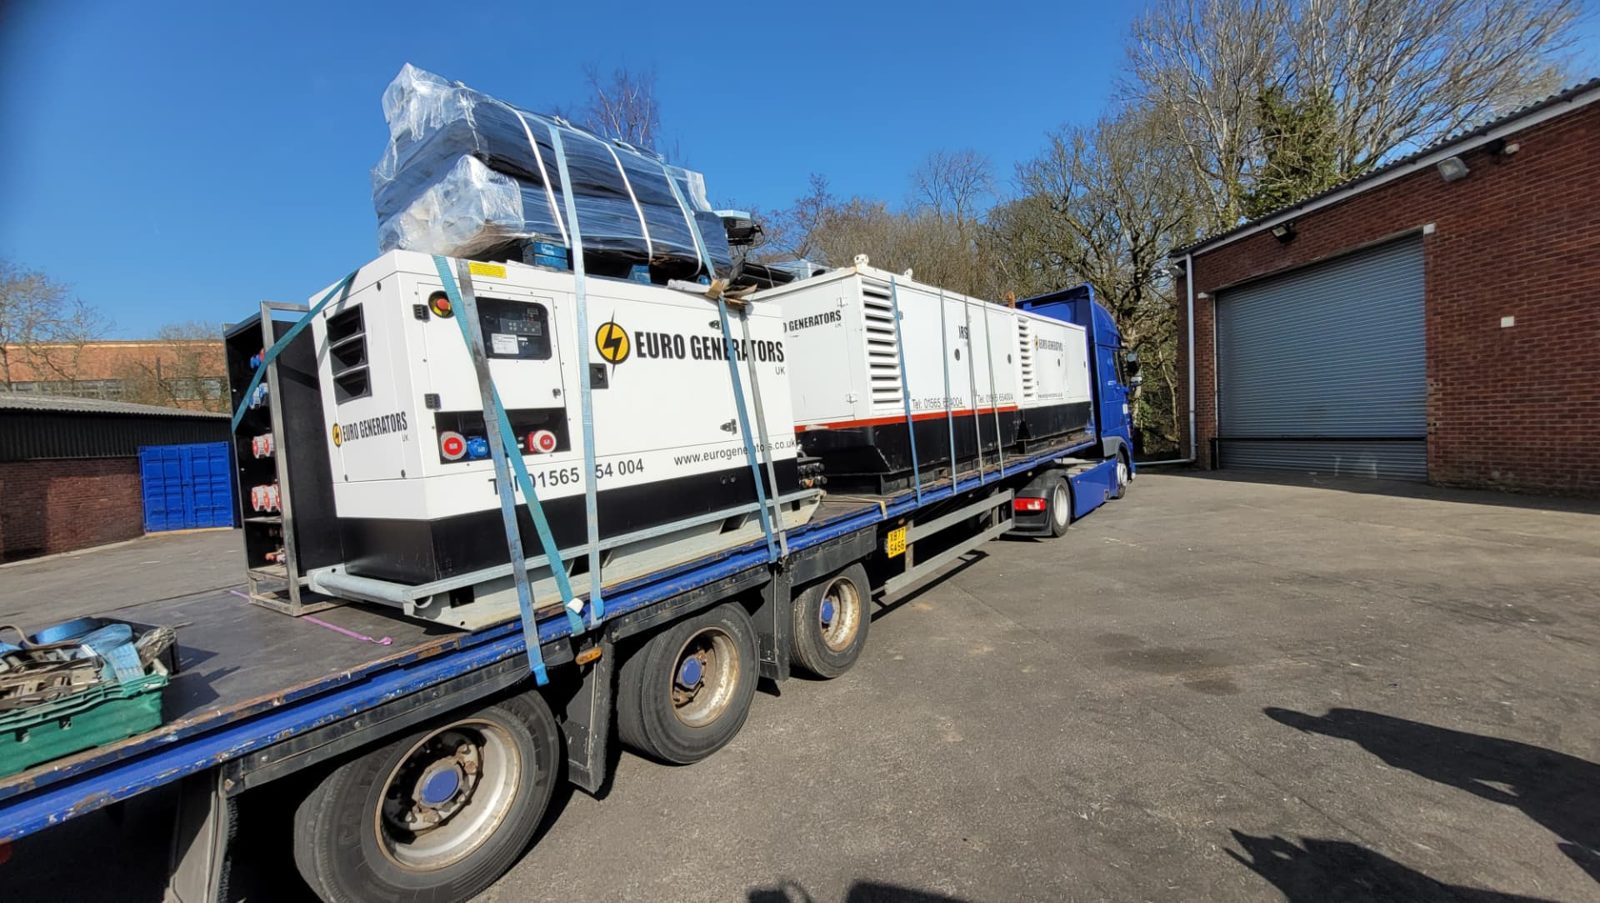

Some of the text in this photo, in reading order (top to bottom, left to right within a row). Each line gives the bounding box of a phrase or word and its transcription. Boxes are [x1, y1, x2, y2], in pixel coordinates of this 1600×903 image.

[788, 309, 842, 331] GENERATORS
[634, 331, 785, 363] EURO GENERATORS
[775, 366, 785, 375] UK
[342, 410, 408, 442] EURO GENERATORS
[488, 475, 519, 495] Tl
[527, 467, 580, 489] 01565
[618, 458, 645, 476] 004
